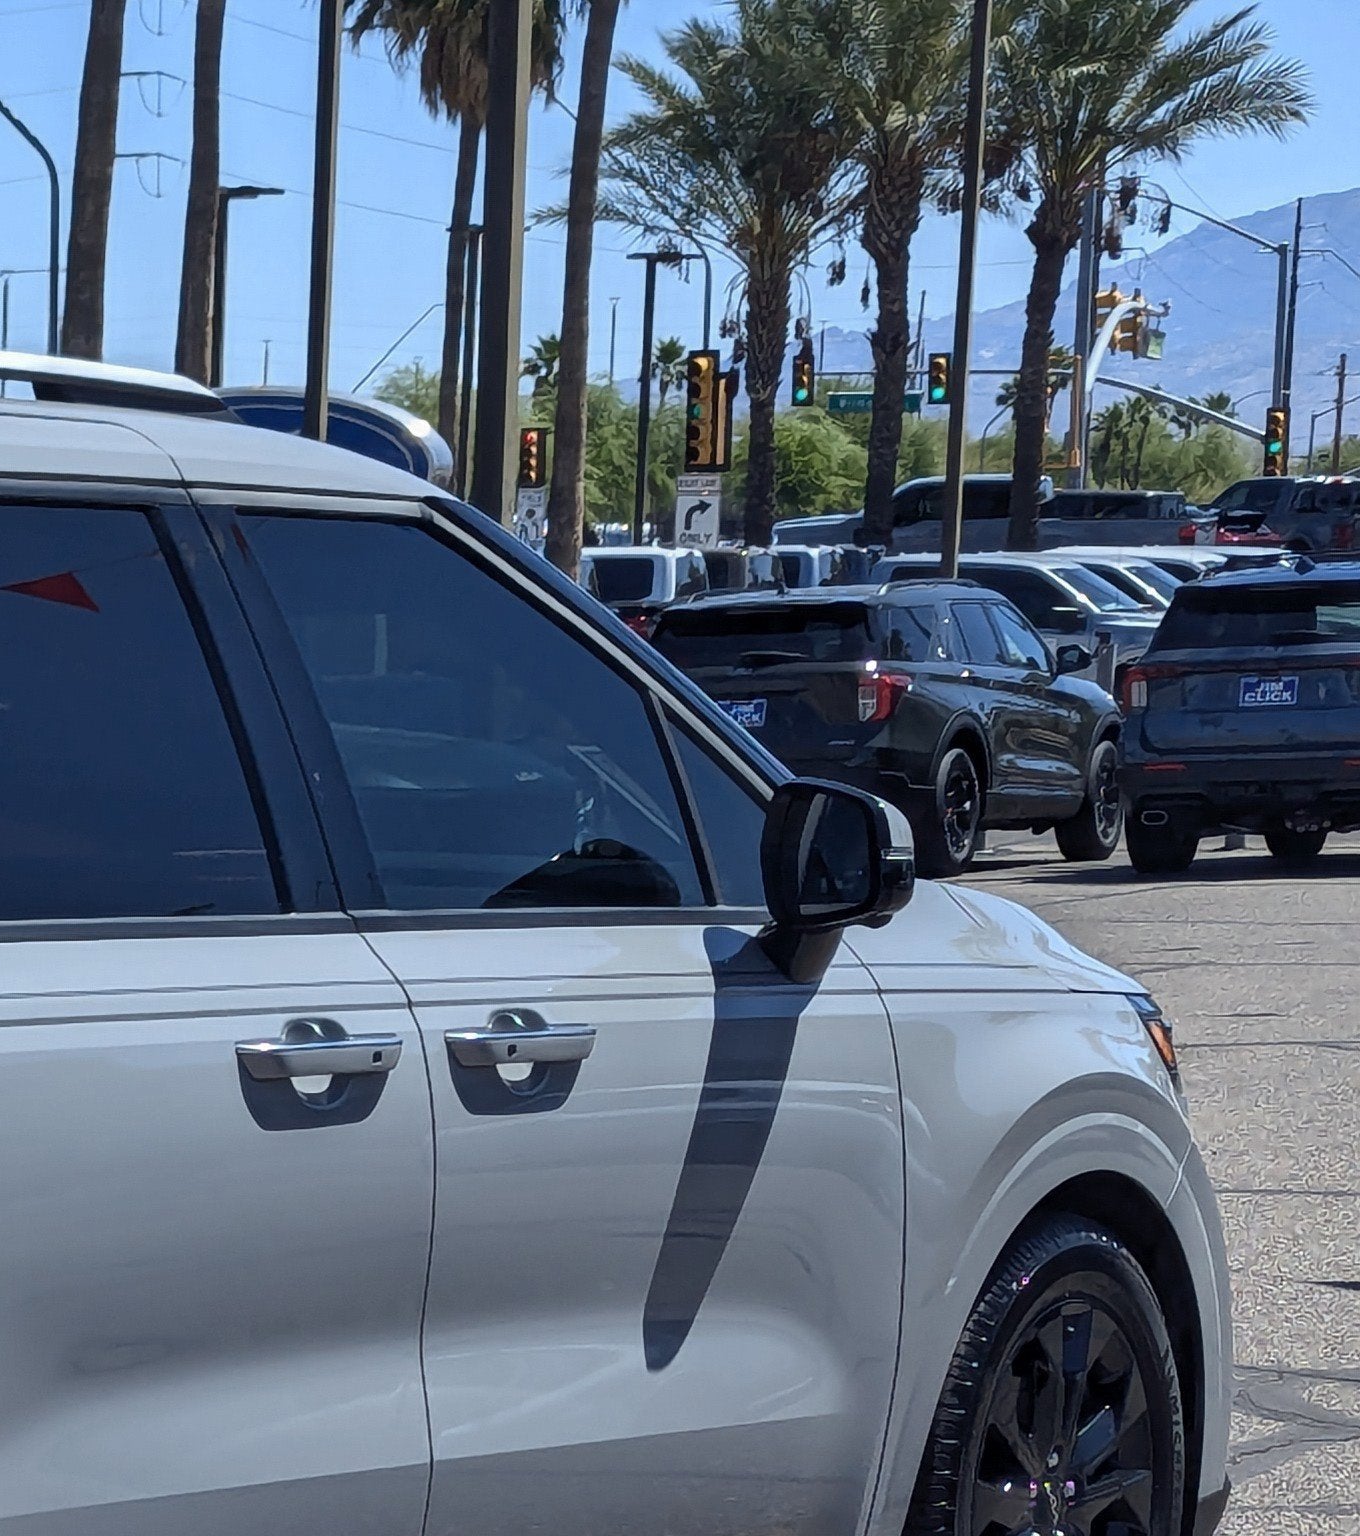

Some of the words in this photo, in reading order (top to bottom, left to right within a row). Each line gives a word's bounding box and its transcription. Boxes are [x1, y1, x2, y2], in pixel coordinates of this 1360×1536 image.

[679, 532, 712, 545] ONLY
[1256, 682, 1284, 691] JIM
[1244, 690, 1292, 701] CLICK
